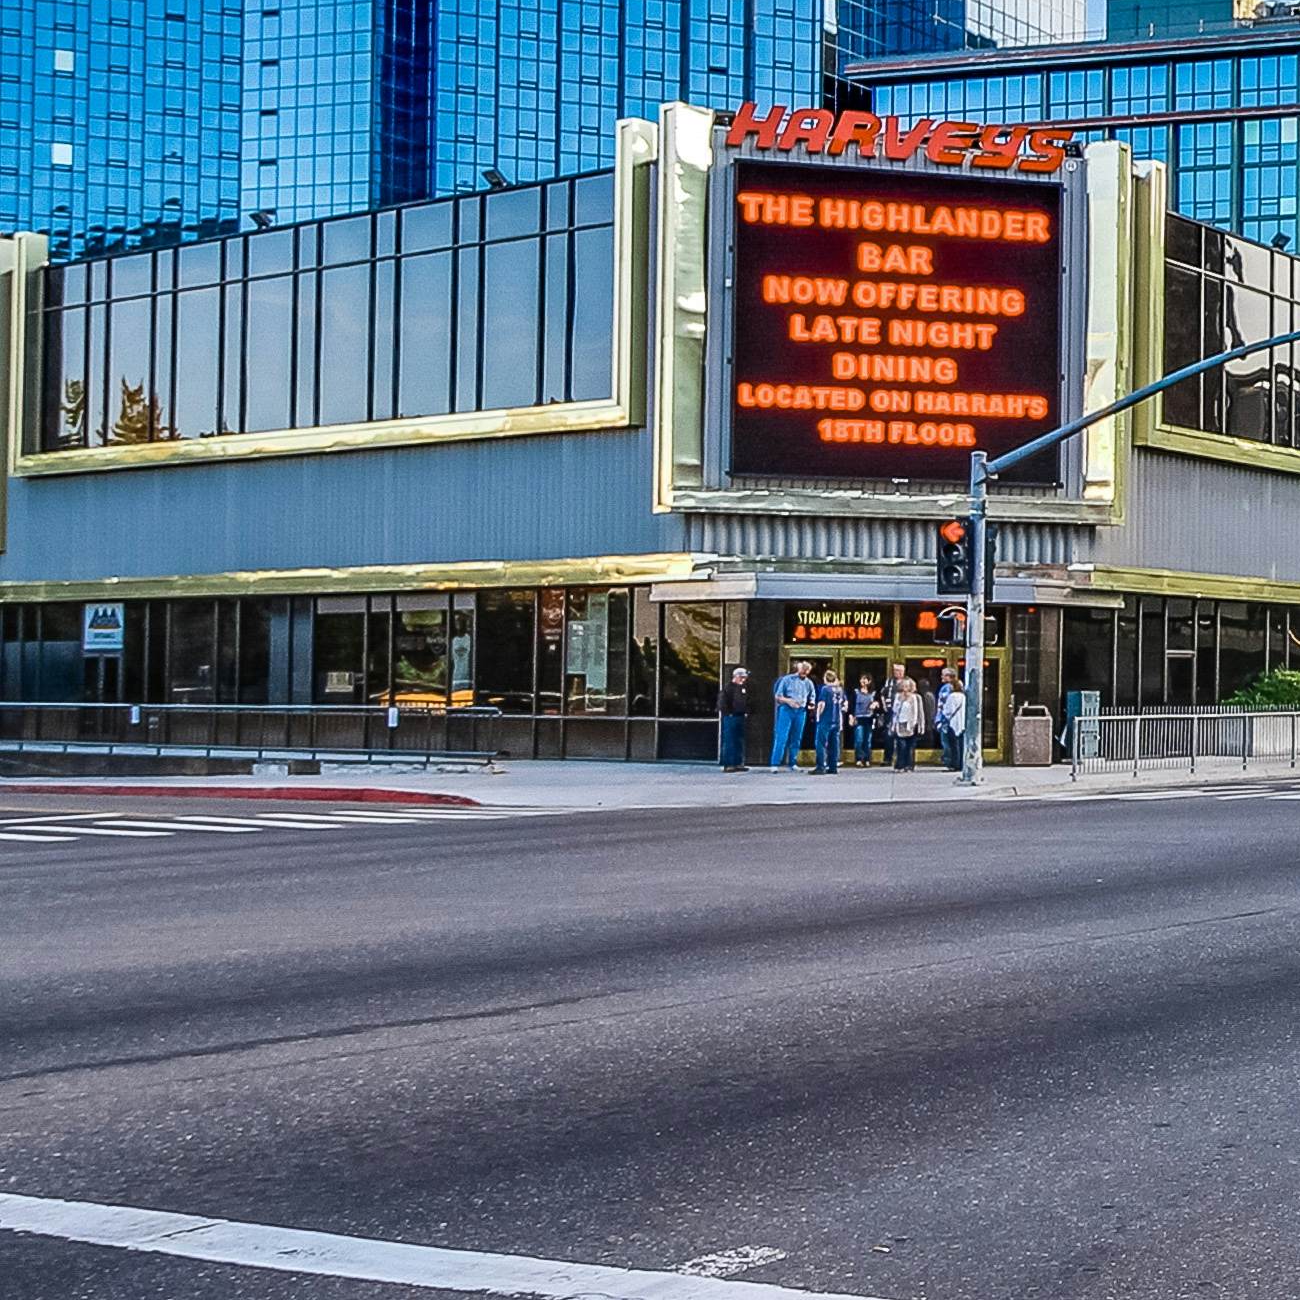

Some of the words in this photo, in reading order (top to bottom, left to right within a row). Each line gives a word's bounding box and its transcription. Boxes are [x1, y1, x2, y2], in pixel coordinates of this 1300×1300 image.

[725, 100, 1075, 174] HARVEYS
[737, 192, 815, 226] THE
[819, 198, 1051, 243] HIGHLANDER
[857, 243, 934, 276] BAR
[762, 275, 849, 306] NOW
[852, 280, 1025, 317] OFFERING
[789, 313, 881, 345] LATE
[888, 319, 998, 351] NIGHT
[832, 351, 958, 384] DINING
[737, 382, 866, 412] LOCATED
[870, 389, 911, 413] ON
[914, 390, 1048, 420] HARRAH'S
[817, 418, 885, 443] 18TH
[887, 421, 977, 447] FLOOR
[797, 610, 832, 625] STRAW
[833, 611, 851, 625] HAT
[853, 611, 881, 626] PIZZA
[810, 626, 856, 640] SPORTS
[857, 626, 883, 640] BAR
